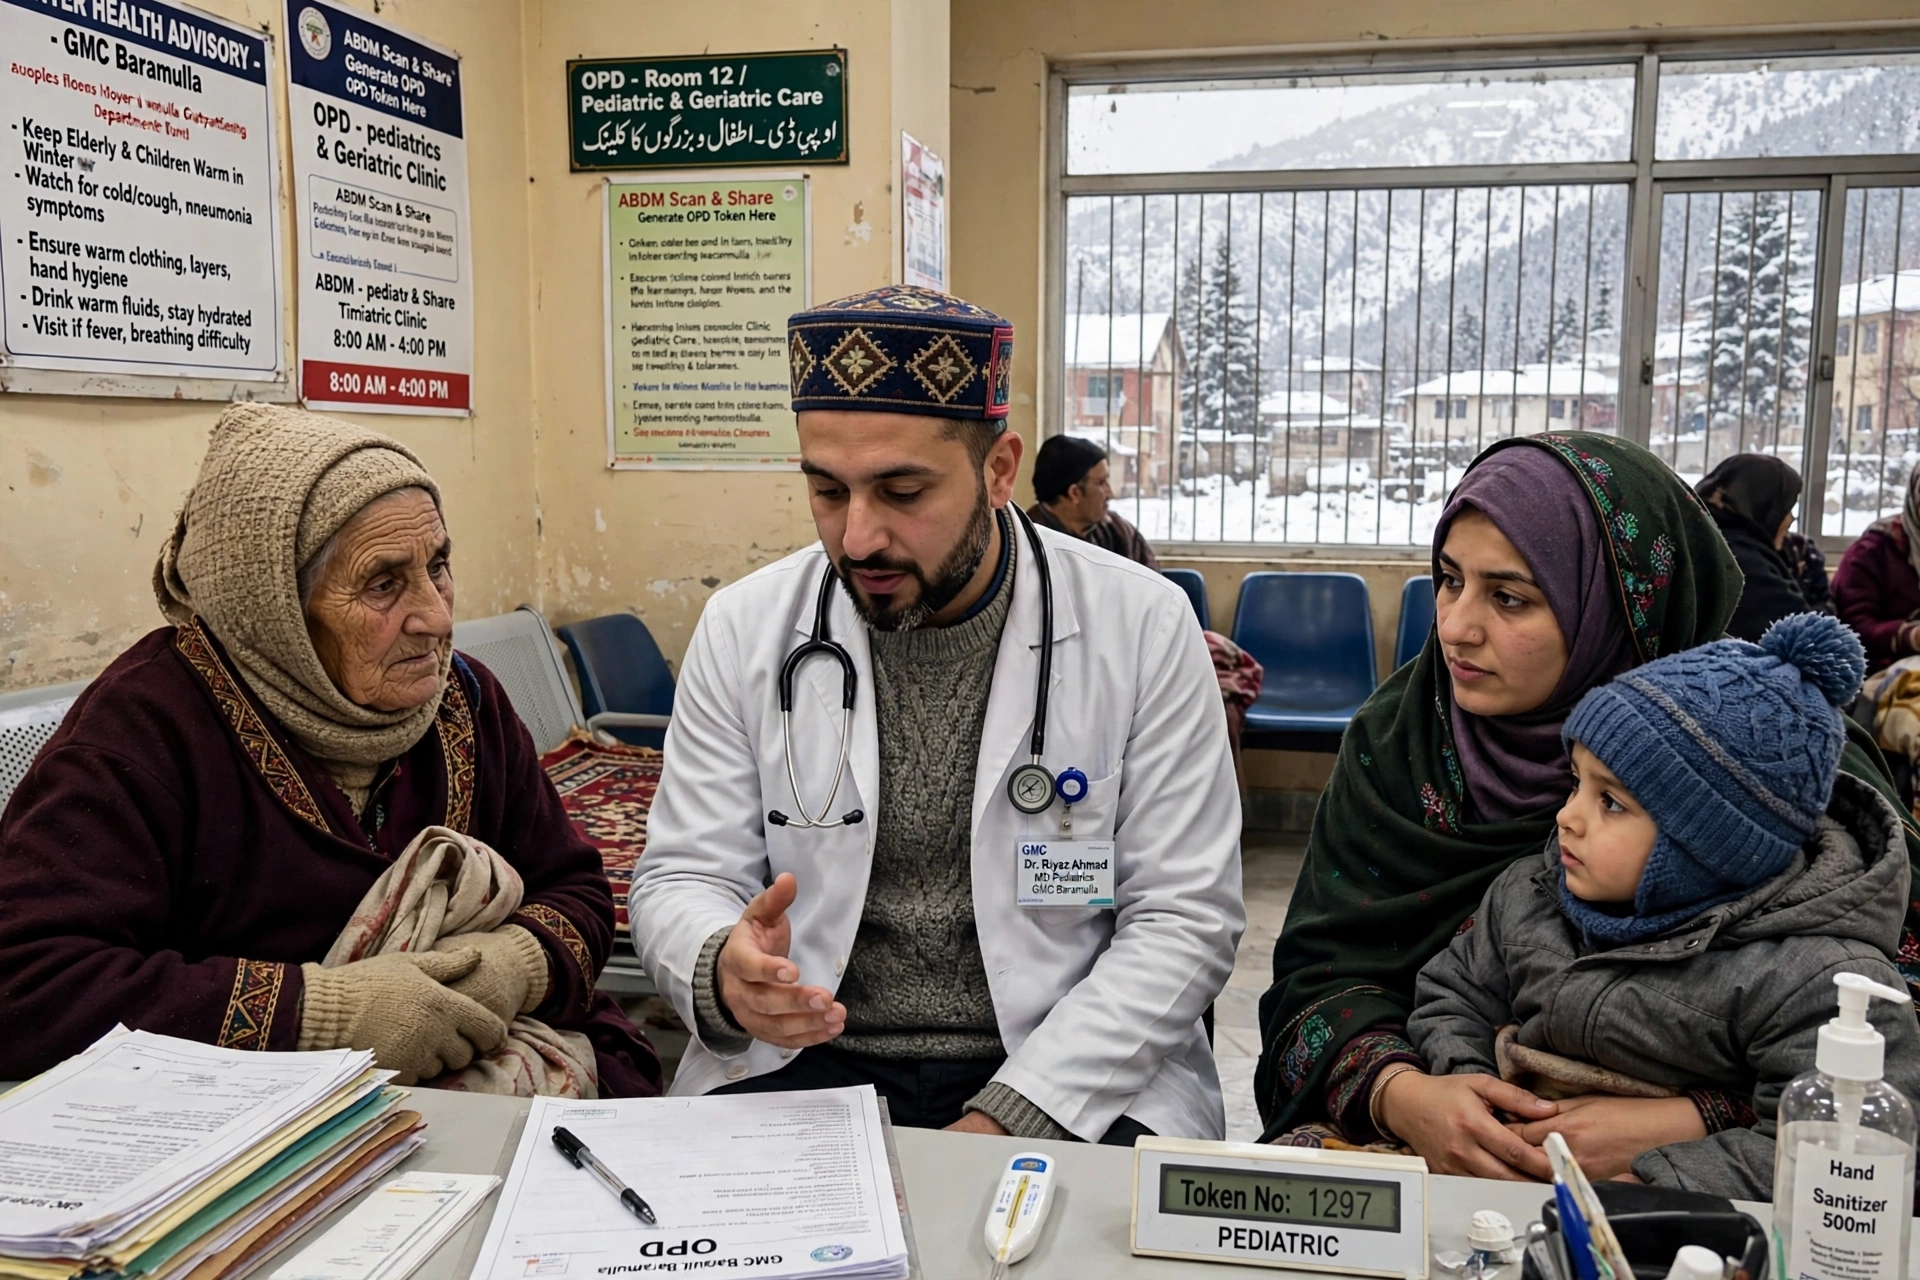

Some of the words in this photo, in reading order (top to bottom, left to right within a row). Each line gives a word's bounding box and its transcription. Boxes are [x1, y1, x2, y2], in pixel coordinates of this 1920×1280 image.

[91, 0, 163, 42] HEALTH
[168, 19, 249, 71] ADVISORY
[63, 27, 110, 65] GMC
[115, 44, 203, 94] Baramulla
[343, 29, 380, 58] ABDM
[382, 44, 410, 70] Scan
[411, 55, 420, 74] &
[422, 61, 453, 88] Share
[344, 53, 399, 88] Generate
[400, 76, 426, 97] OPD
[580, 70, 626, 91] OPD
[644, 68, 703, 89] Room
[708, 65, 734, 86] 12
[738, 64, 748, 86] /
[345, 76, 368, 98] OPD
[370, 85, 400, 110] Token
[401, 96, 427, 118] Here
[580, 93, 664, 114] Pediatric
[669, 92, 684, 110] &
[688, 88, 772, 110] Geriatric
[776, 87, 824, 107] Care
[313, 101, 351, 134] OPD
[367, 123, 441, 162] pediatrics
[630, 121, 648, 152] کا
[22, 116, 63, 149] Keep
[67, 128, 117, 161] Elderly
[121, 142, 132, 160] &
[135, 144, 191, 174] Children
[193, 157, 230, 183] Warm
[232, 166, 244, 186] in
[24, 140, 75, 170] Winter
[316, 134, 329, 161] &
[334, 139, 403, 180] Geriatric
[406, 161, 447, 192] Clinic
[25, 165, 74, 193] Watch
[77, 175, 99, 197] for
[102, 182, 183, 216] cold/cough,
[335, 187, 367, 207] ABDM
[368, 196, 393, 215] Scan
[405, 205, 431, 224] Share
[618, 192, 665, 208] ABDM
[669, 191, 706, 207] Scan
[710, 190, 723, 206] &
[727, 189, 774, 206] Share
[27, 196, 105, 223] symptoms
[637, 211, 684, 224] Generate
[686, 210, 711, 223] OPD
[713, 209, 746, 222] Token
[749, 208, 777, 221] Here
[28, 230, 81, 257] Ensure
[85, 245, 125, 264] warm
[129, 246, 187, 276] clothing,
[190, 254, 231, 281] layers,
[29, 256, 68, 281] hand
[72, 261, 128, 290] hygiene
[315, 272, 355, 295] ABDM
[366, 282, 409, 303] pediatr
[411, 287, 420, 305] &
[422, 289, 456, 310] Share
[31, 285, 74, 310] Drink
[77, 295, 119, 314] warm
[122, 295, 164, 322] fluids,
[167, 303, 195, 327] stay
[198, 304, 252, 328] hydrated
[338, 301, 392, 326] Timiatric
[394, 309, 428, 330] Clinic
[32, 314, 69, 338] Visit
[72, 317, 83, 339] if
[86, 318, 127, 345] fever,
[130, 323, 194, 351] breathing
[197, 330, 251, 355] difficulty
[333, 328, 362, 350] 8:00
[365, 332, 387, 352] AM
[398, 336, 425, 356] 4:00
[428, 339, 447, 358] PM
[329, 371, 361, 394] 8:00
[363, 374, 387, 395] AM
[398, 377, 427, 398] 4:00
[428, 379, 449, 399] PM
[1022, 845, 1047, 856] GMC
[1024, 859, 1040, 870] Dr.
[1071, 858, 1108, 871] Ahmad
[1031, 883, 1055, 895] GMC
[1034, 872, 1051, 882] MD
[1829, 1159, 1875, 1181] Hand
[1179, 1178, 1248, 1212] Token
[1253, 1183, 1292, 1215] No:
[1306, 1186, 1373, 1221] 1297
[1812, 1187, 1888, 1213] Sanitizer
[1822, 1211, 1876, 1235] 500ml
[639, 1237, 718, 1259] OPD
[1217, 1225, 1341, 1258] PEDIATRIC
[742, 1254, 783, 1269] GMC
